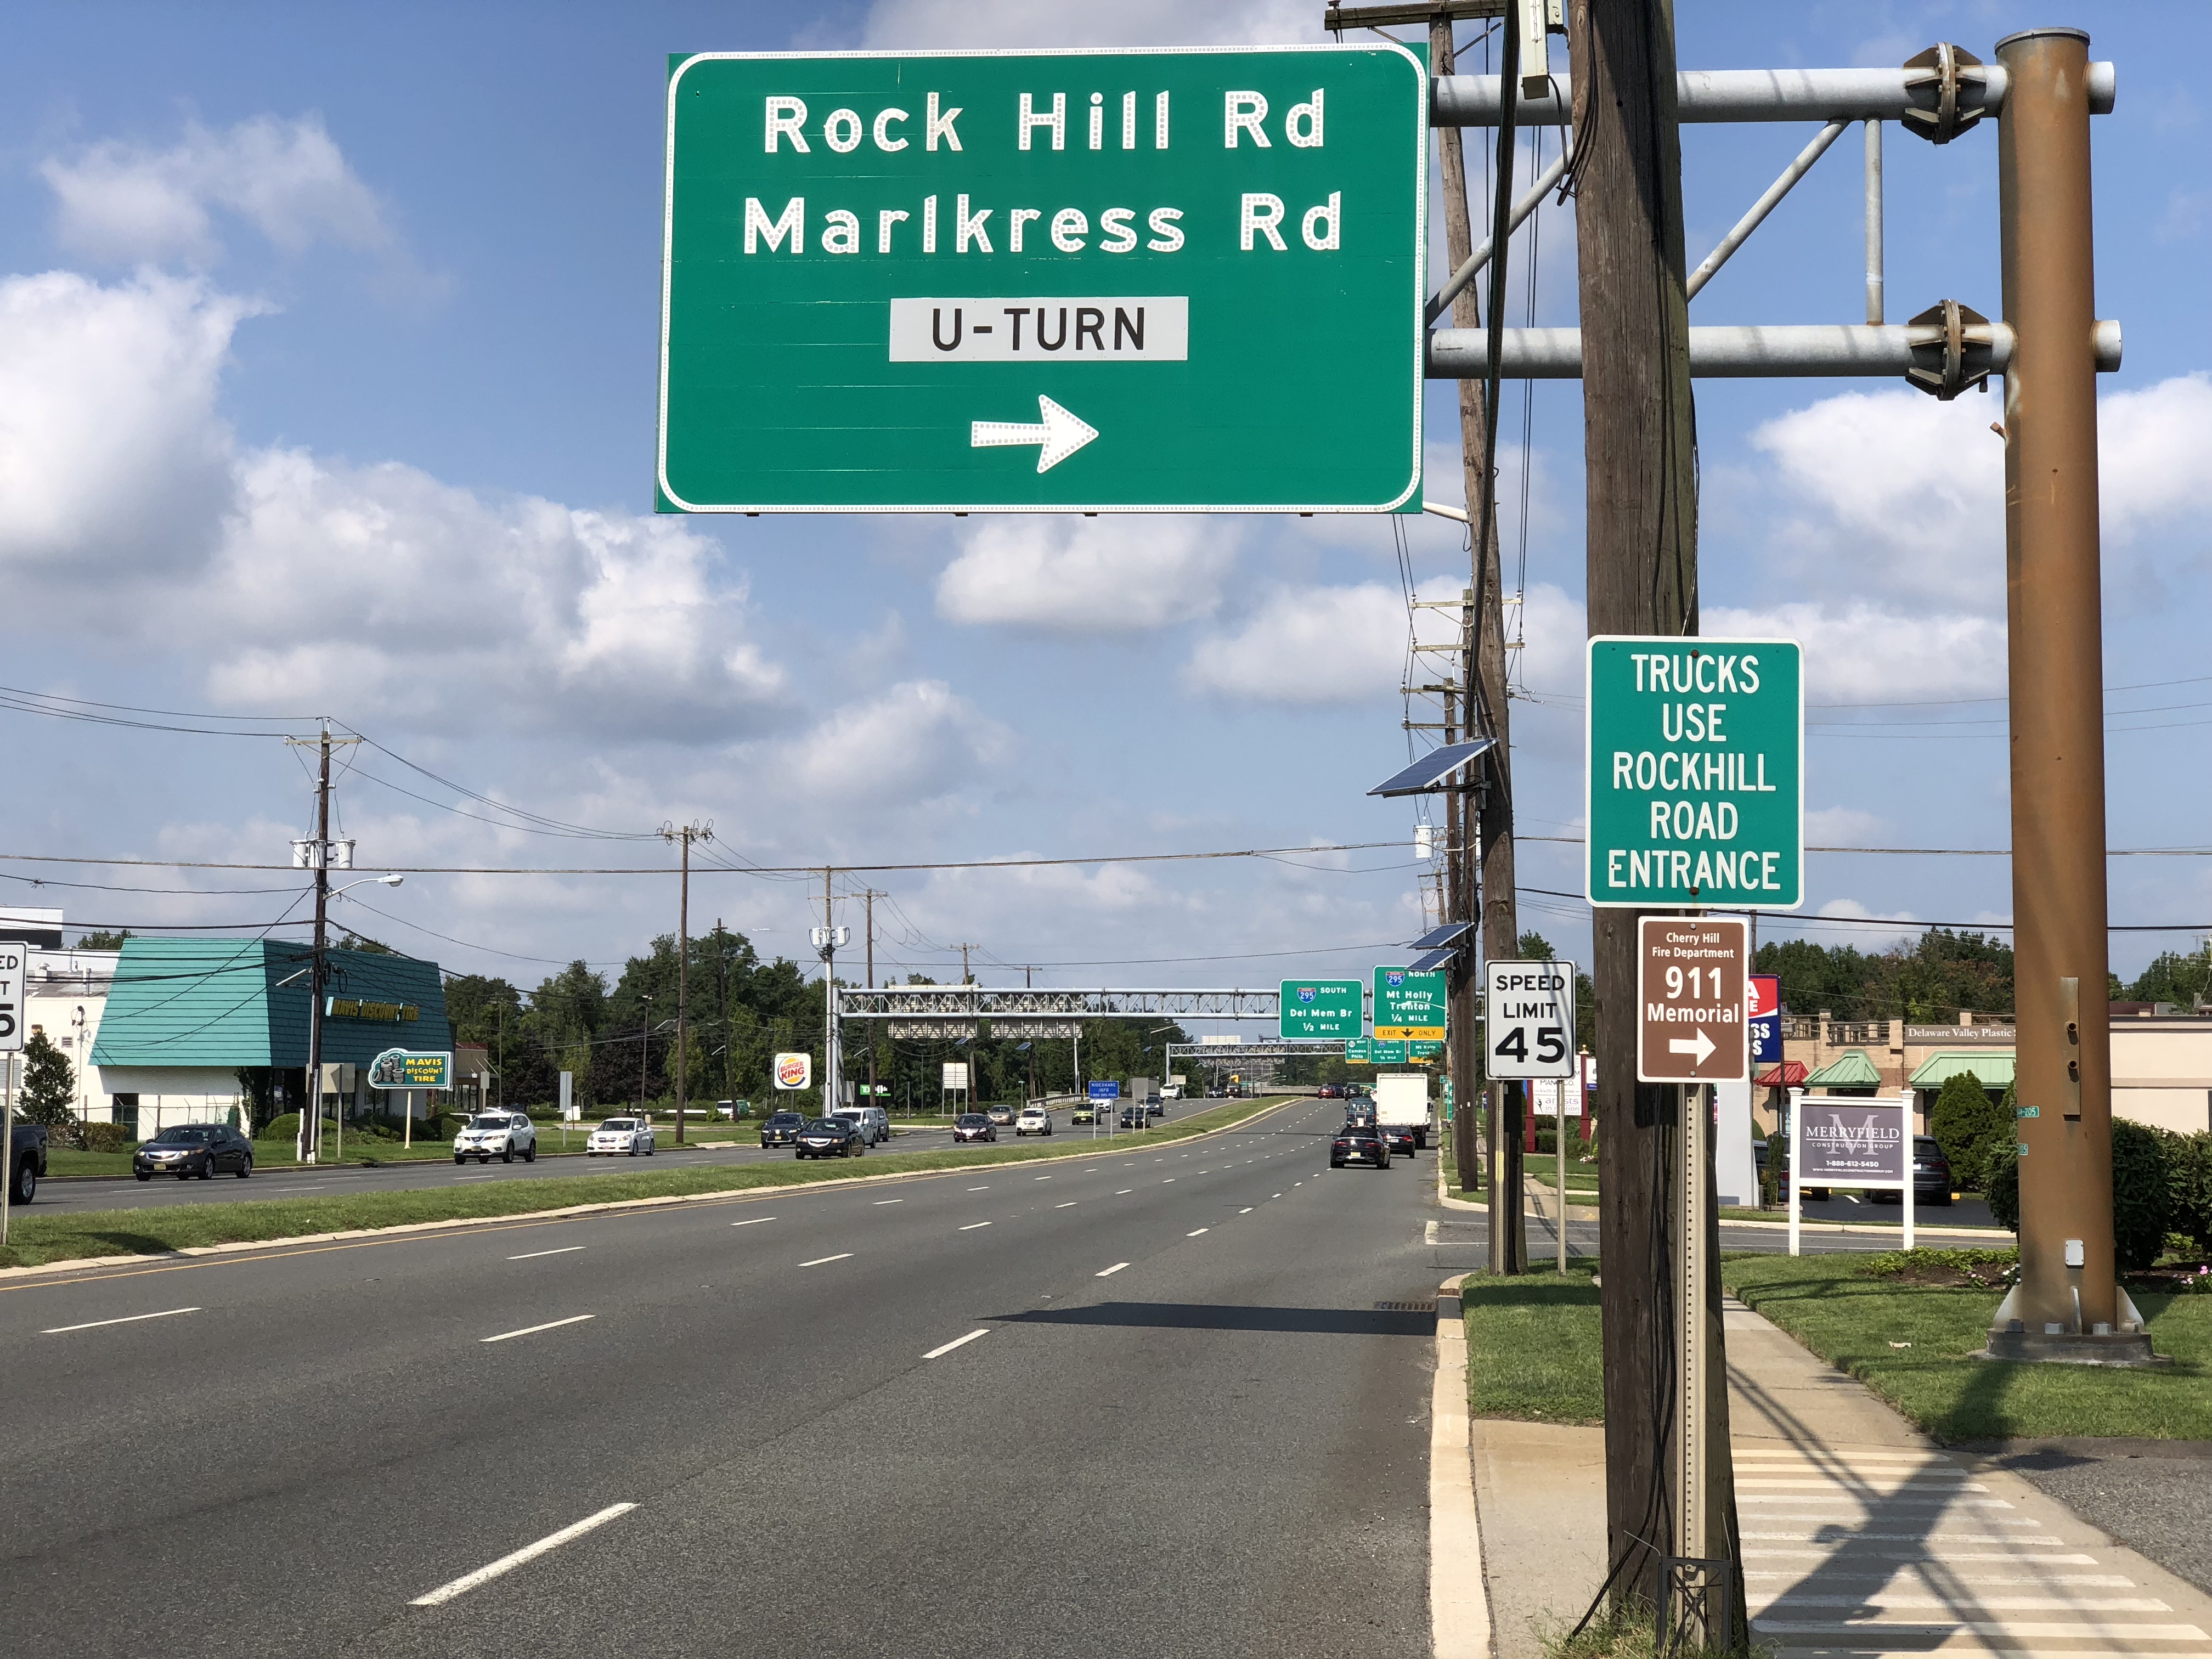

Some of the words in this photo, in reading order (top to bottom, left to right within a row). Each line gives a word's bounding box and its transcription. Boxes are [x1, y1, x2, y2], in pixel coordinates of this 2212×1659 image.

[764, 92, 963, 153] Rock
[1019, 89, 1170, 150] Hill
[1225, 88, 1324, 149] Rd
[744, 194, 1185, 254] Marlkress
[1240, 191, 1341, 251] Rd
[931, 307, 1146, 352] U-TURN
[1631, 654, 1759, 693] TRUCKS
[1663, 703, 1726, 742] USE
[1613, 752, 1776, 791] ROCKHILL
[1651, 801, 1738, 840] ROAD
[1609, 849, 1781, 890] ENTRANCE
[1666, 932, 1700, 945] Cherry
[1703, 933, 1719, 943] Hill
[1652, 946, 1671, 957] Fire
[1674, 947, 1734, 960] Department
[1496, 975, 1565, 991] SPEED
[1666, 966, 1721, 999] 911
[1386, 990, 1400, 998] Mt
[1405, 990, 1433, 1002] Holly
[1290, 1009, 1306, 1017] Del
[1311, 1009, 1335, 1017] Mem
[1340, 1009, 1352, 1017] Br
[1390, 1002, 1430, 1011] Trenton
[1504, 1003, 1557, 1018] LIMIT
[1647, 1003, 1739, 1023] Memorial
[1909, 1028, 1950, 1037] Delaware
[1952, 1028, 1979, 1039] Valley
[1981, 1028, 2012, 1037] Plastic
[1495, 1027, 1565, 1063] 45
[781, 1062, 804, 1073] BURGER
[782, 1067, 804, 1080] KING
[1806, 1126, 1900, 1139] MERRYFIELD
